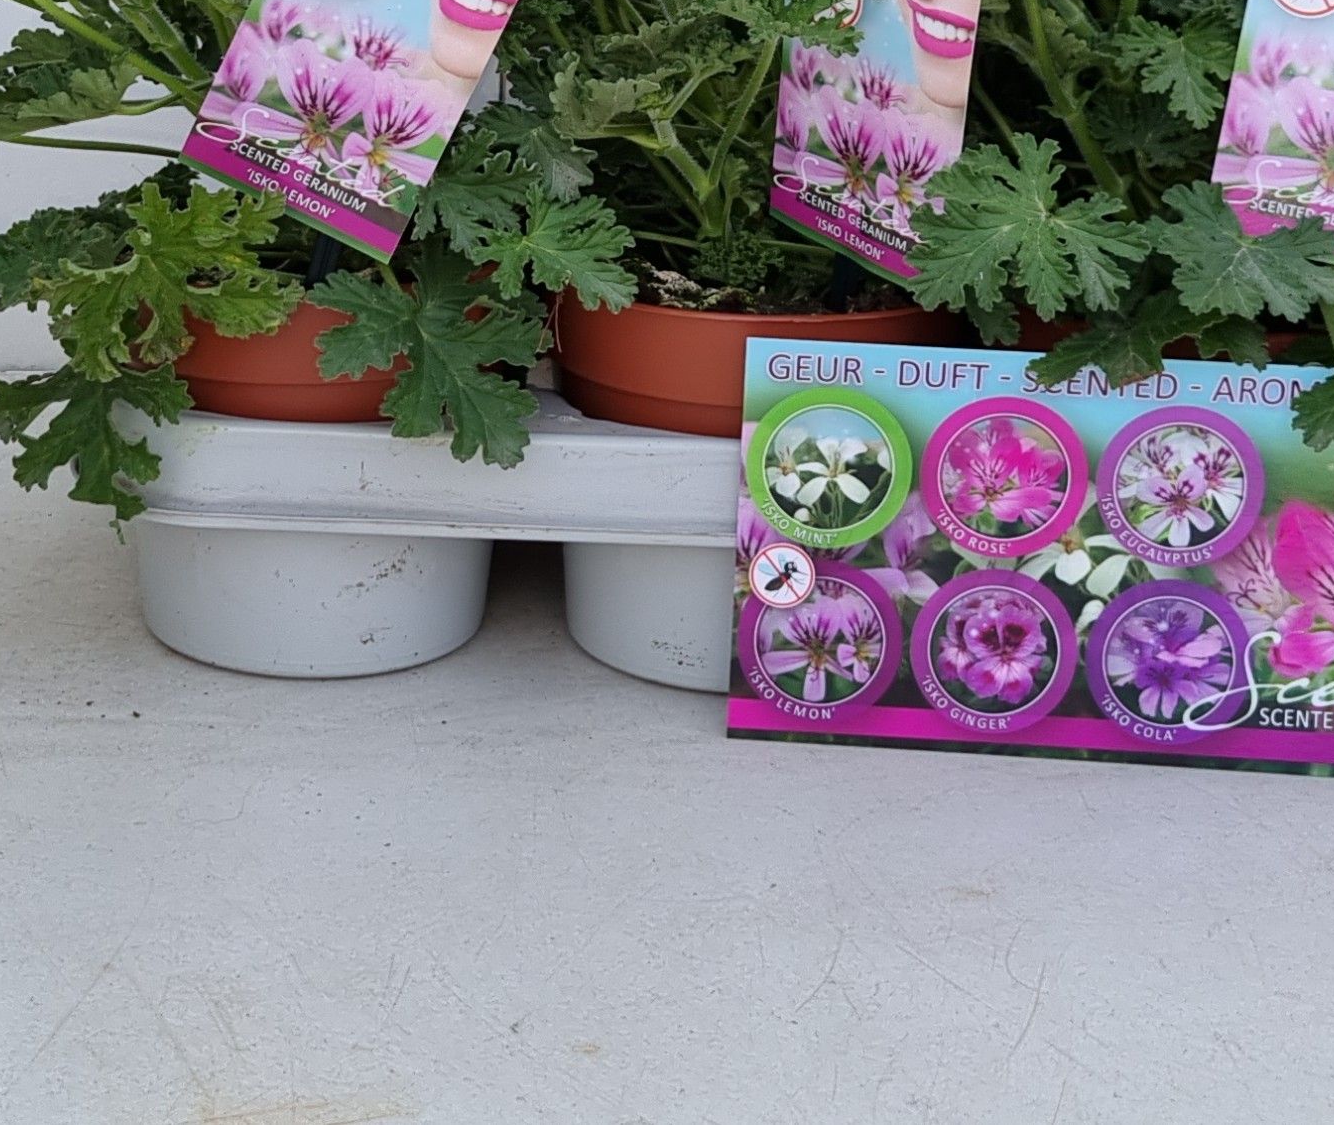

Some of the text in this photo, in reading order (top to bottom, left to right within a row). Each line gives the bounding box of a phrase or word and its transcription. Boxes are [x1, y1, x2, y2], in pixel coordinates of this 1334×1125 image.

[196, 108, 405, 207] Scented
[230, 141, 367, 213] SCENTED GERANIUM
[798, 190, 907, 252] SCENTED GERANIUM
[815, 216, 886, 261] 'ISKO LEMON'
[767, 353, 863, 384] GEUR
[897, 359, 990, 390] DUFT
[761, 498, 838, 545] 'ISKO MINT'
[937, 509, 1012, 555] 'ISKO ROSE'
[1101, 493, 1214, 563] 'ISKO EUCALYPTUS'
[750, 666, 836, 721] 'ISKO LEMON'
[921, 675, 1012, 730] 'ISKO GINGER'
[1100, 693, 1177, 741] 'ISKO COLA'
